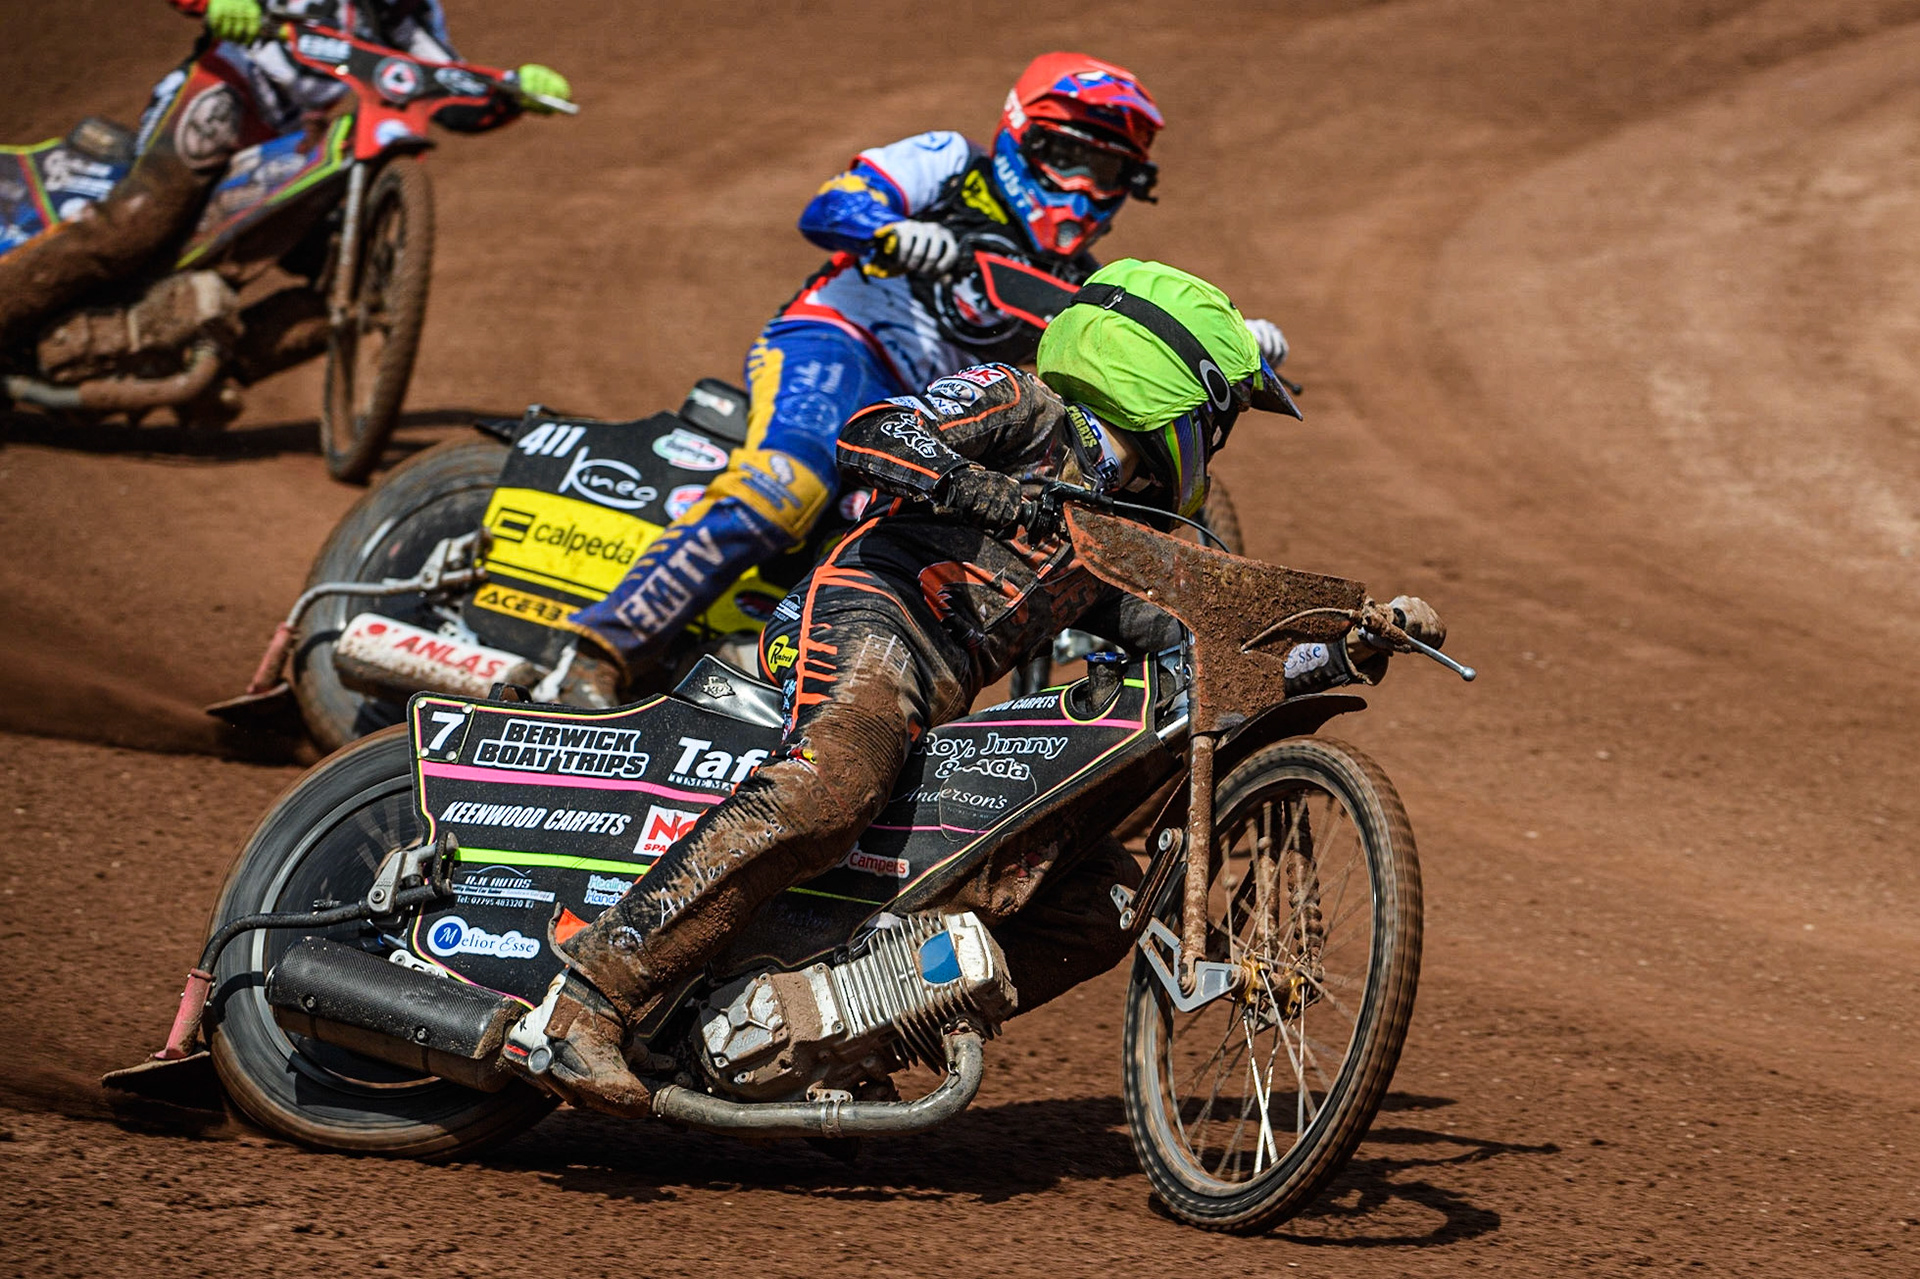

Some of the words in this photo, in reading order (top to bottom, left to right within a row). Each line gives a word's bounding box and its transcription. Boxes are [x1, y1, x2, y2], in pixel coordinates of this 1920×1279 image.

[517, 422, 587, 458] 411
[535, 519, 635, 565] calpeda
[400, 635, 505, 678] ANLAS
[1012, 695, 1059, 710] CARPETS
[429, 711, 465, 750] 7
[502, 719, 641, 753] BERWICK
[474, 740, 556, 771] BOAT
[558, 751, 649, 779] TRIPS
[439, 801, 547, 829] KEENWOOD
[544, 809, 632, 836] CARPETS
[849, 852, 906, 874] Campers
[437, 926, 496, 950] Melior
[500, 936, 535, 953] Esse
